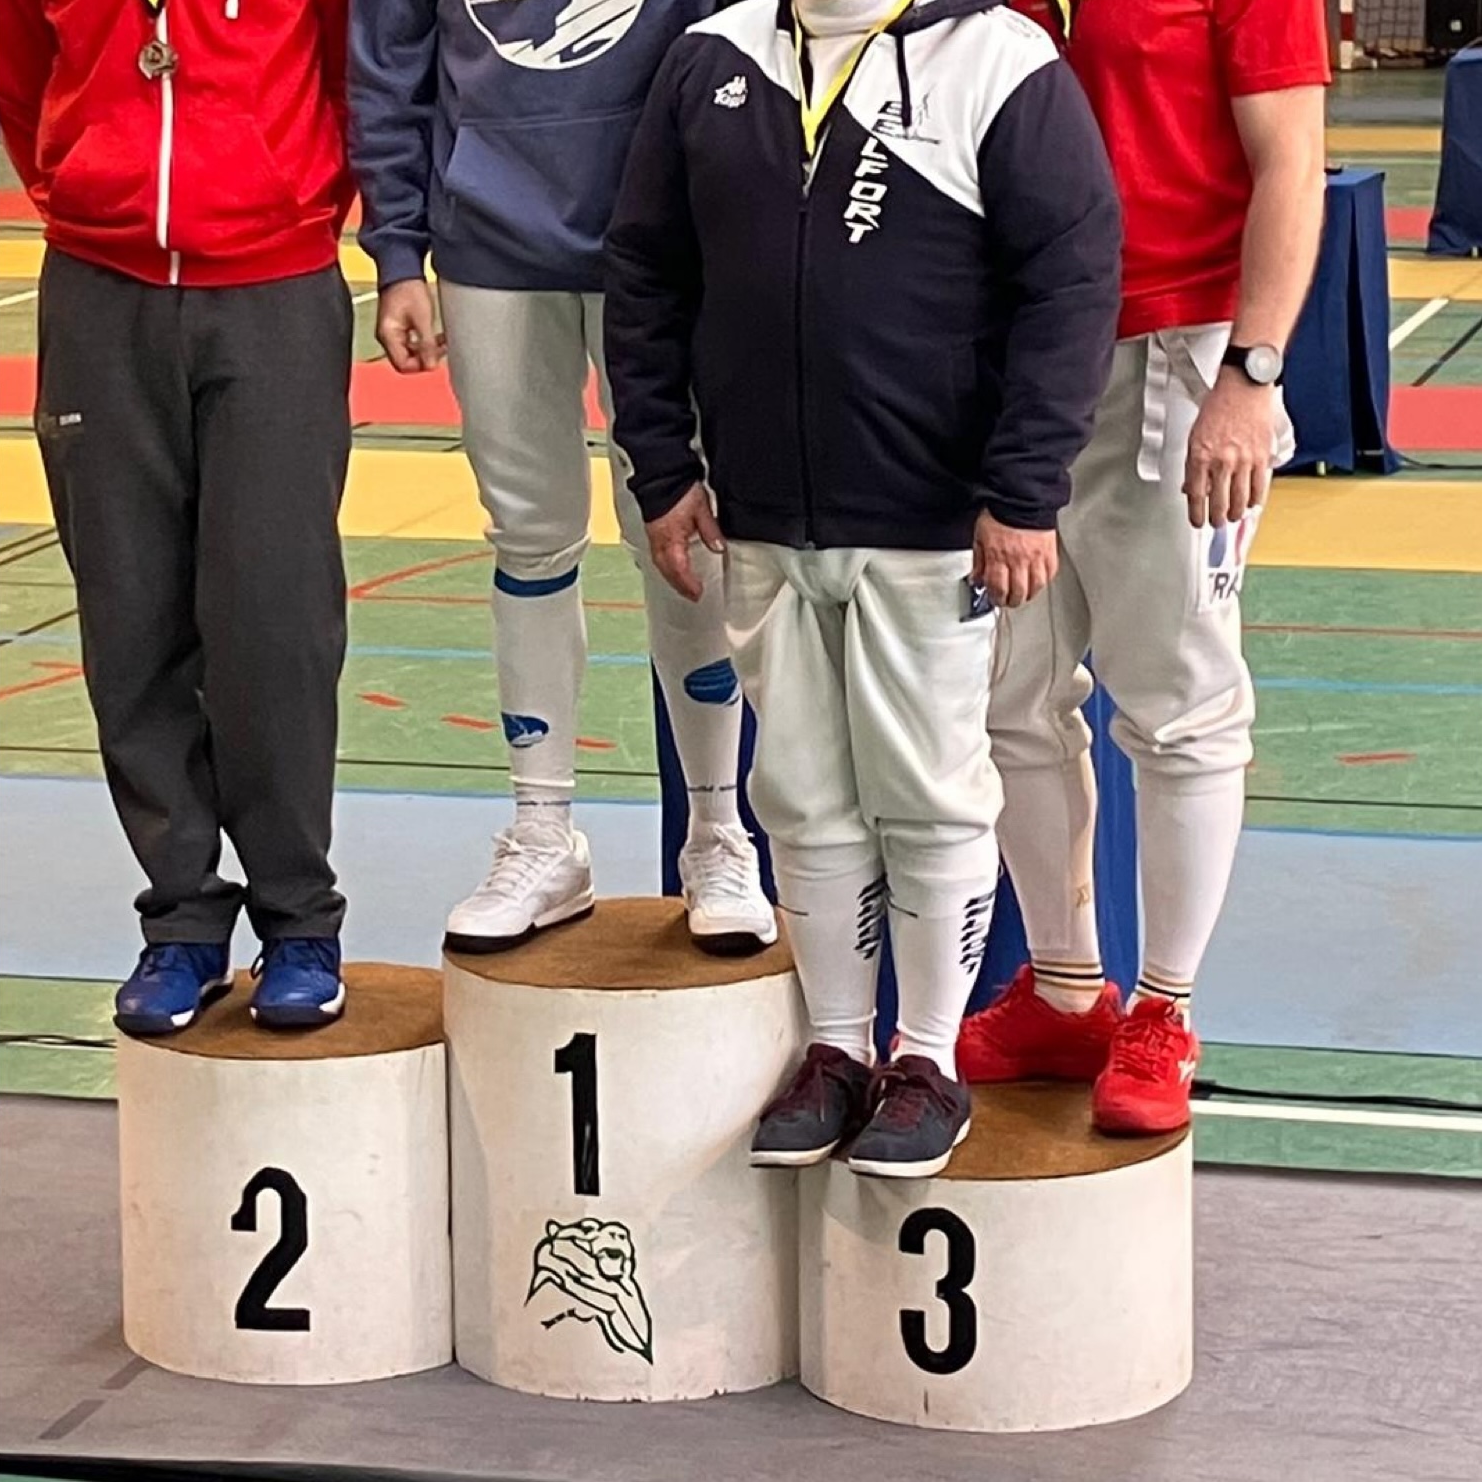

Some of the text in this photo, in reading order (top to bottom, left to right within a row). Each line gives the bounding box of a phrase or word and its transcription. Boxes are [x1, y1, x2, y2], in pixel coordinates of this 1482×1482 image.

[553, 1031, 601, 1198] 1
[230, 1166, 311, 1332] 2
[897, 1206, 978, 1376] 3
